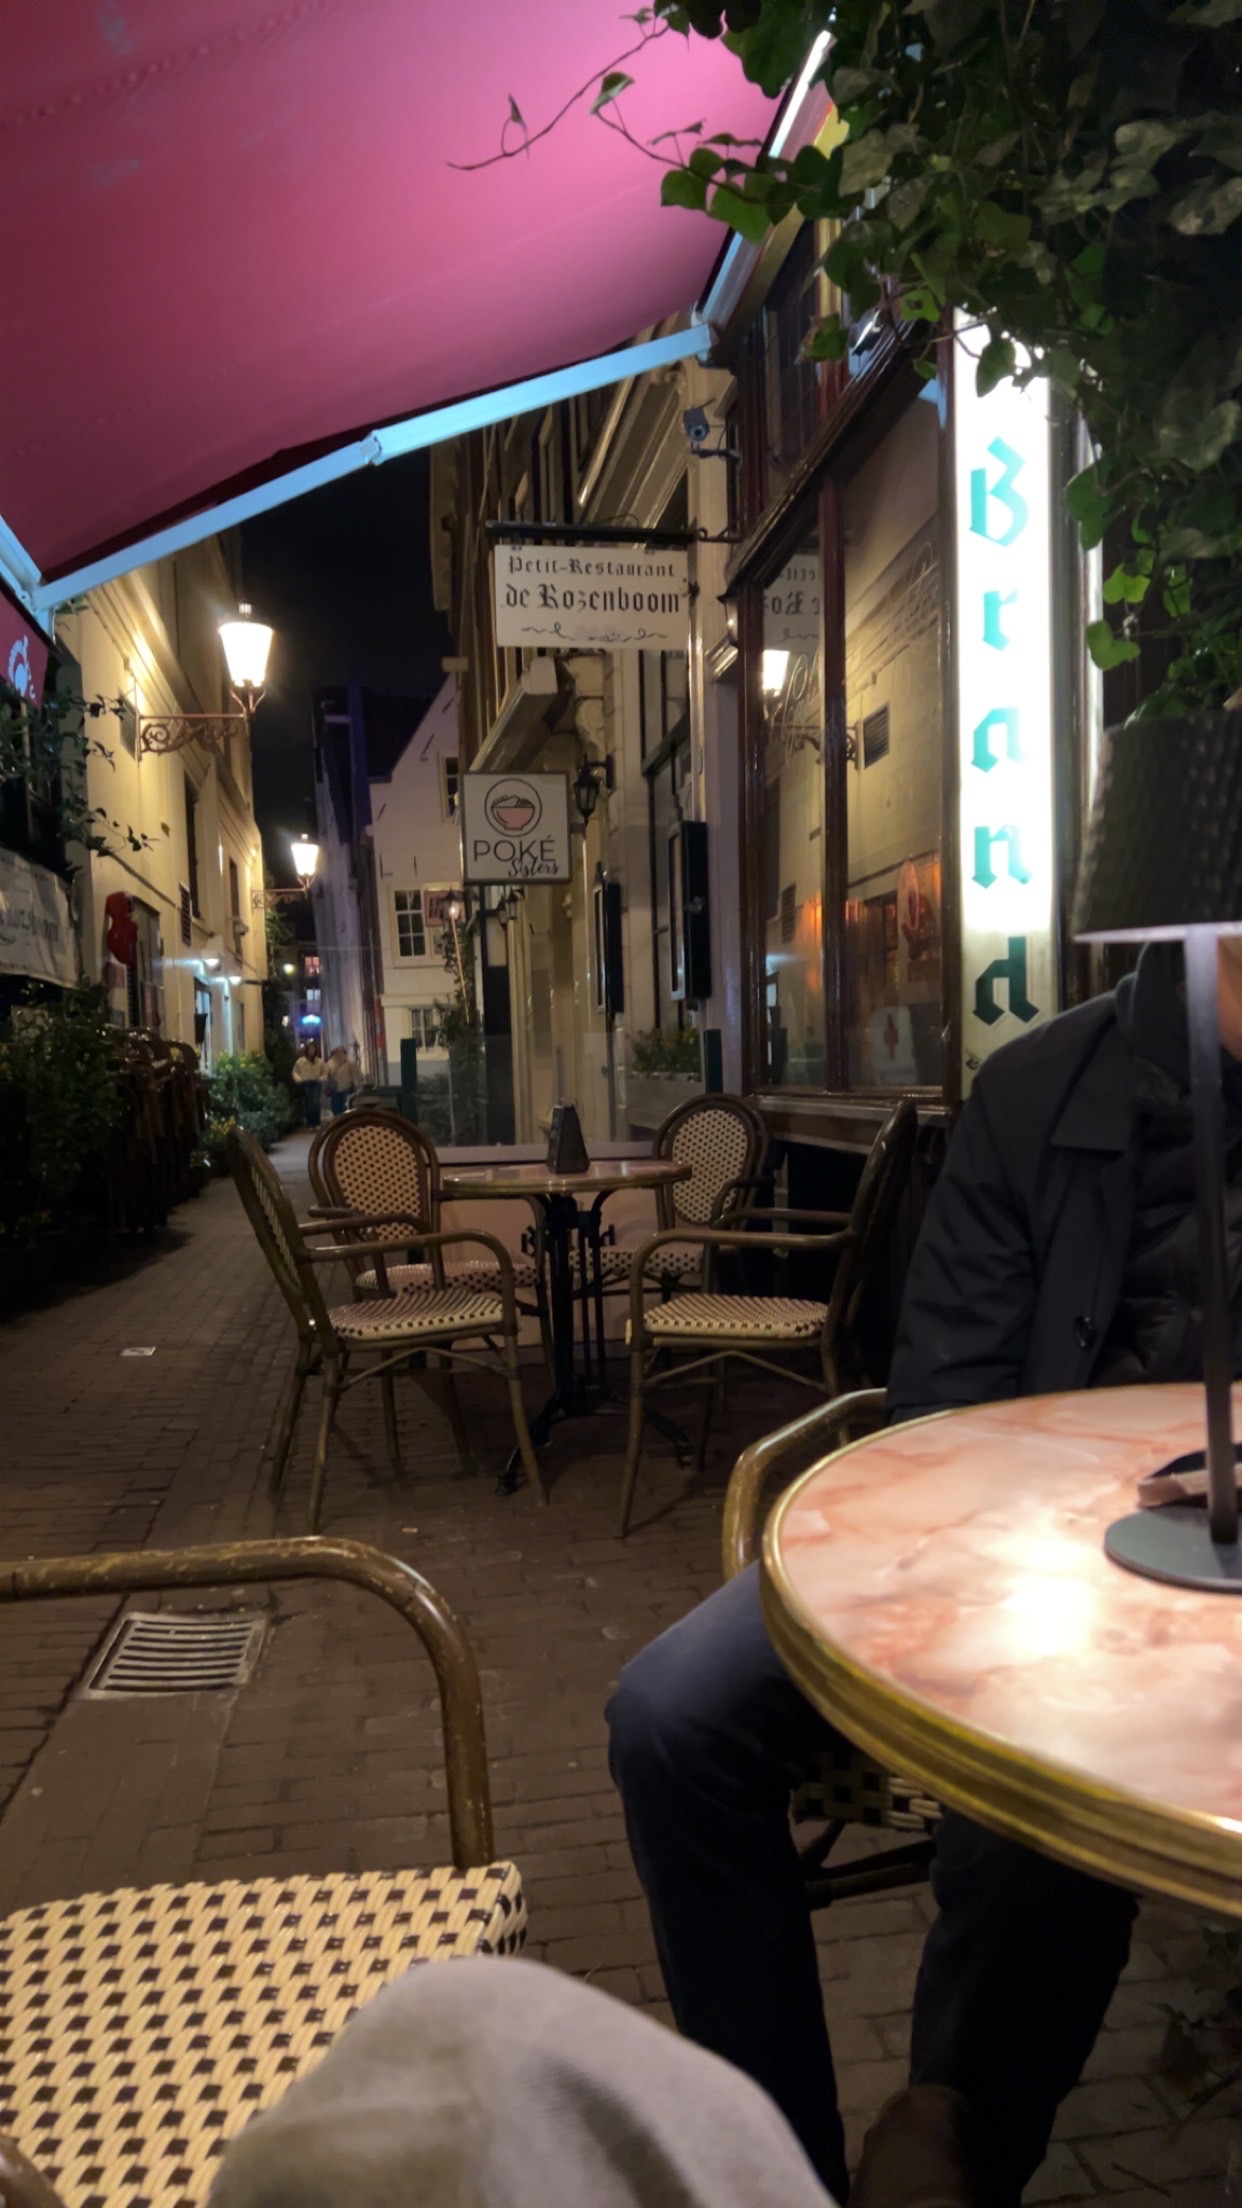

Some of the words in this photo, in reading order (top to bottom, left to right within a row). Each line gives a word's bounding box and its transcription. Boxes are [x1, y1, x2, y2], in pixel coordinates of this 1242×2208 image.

[509, 555, 675, 577] Petit-Restaurant
[505, 583, 531, 608] de
[537, 582, 680, 614] Rozenboom
[970, 435, 1040, 1026] Brand
[473, 834, 556, 862] POKÉ
[508, 856, 560, 877] Sisters
